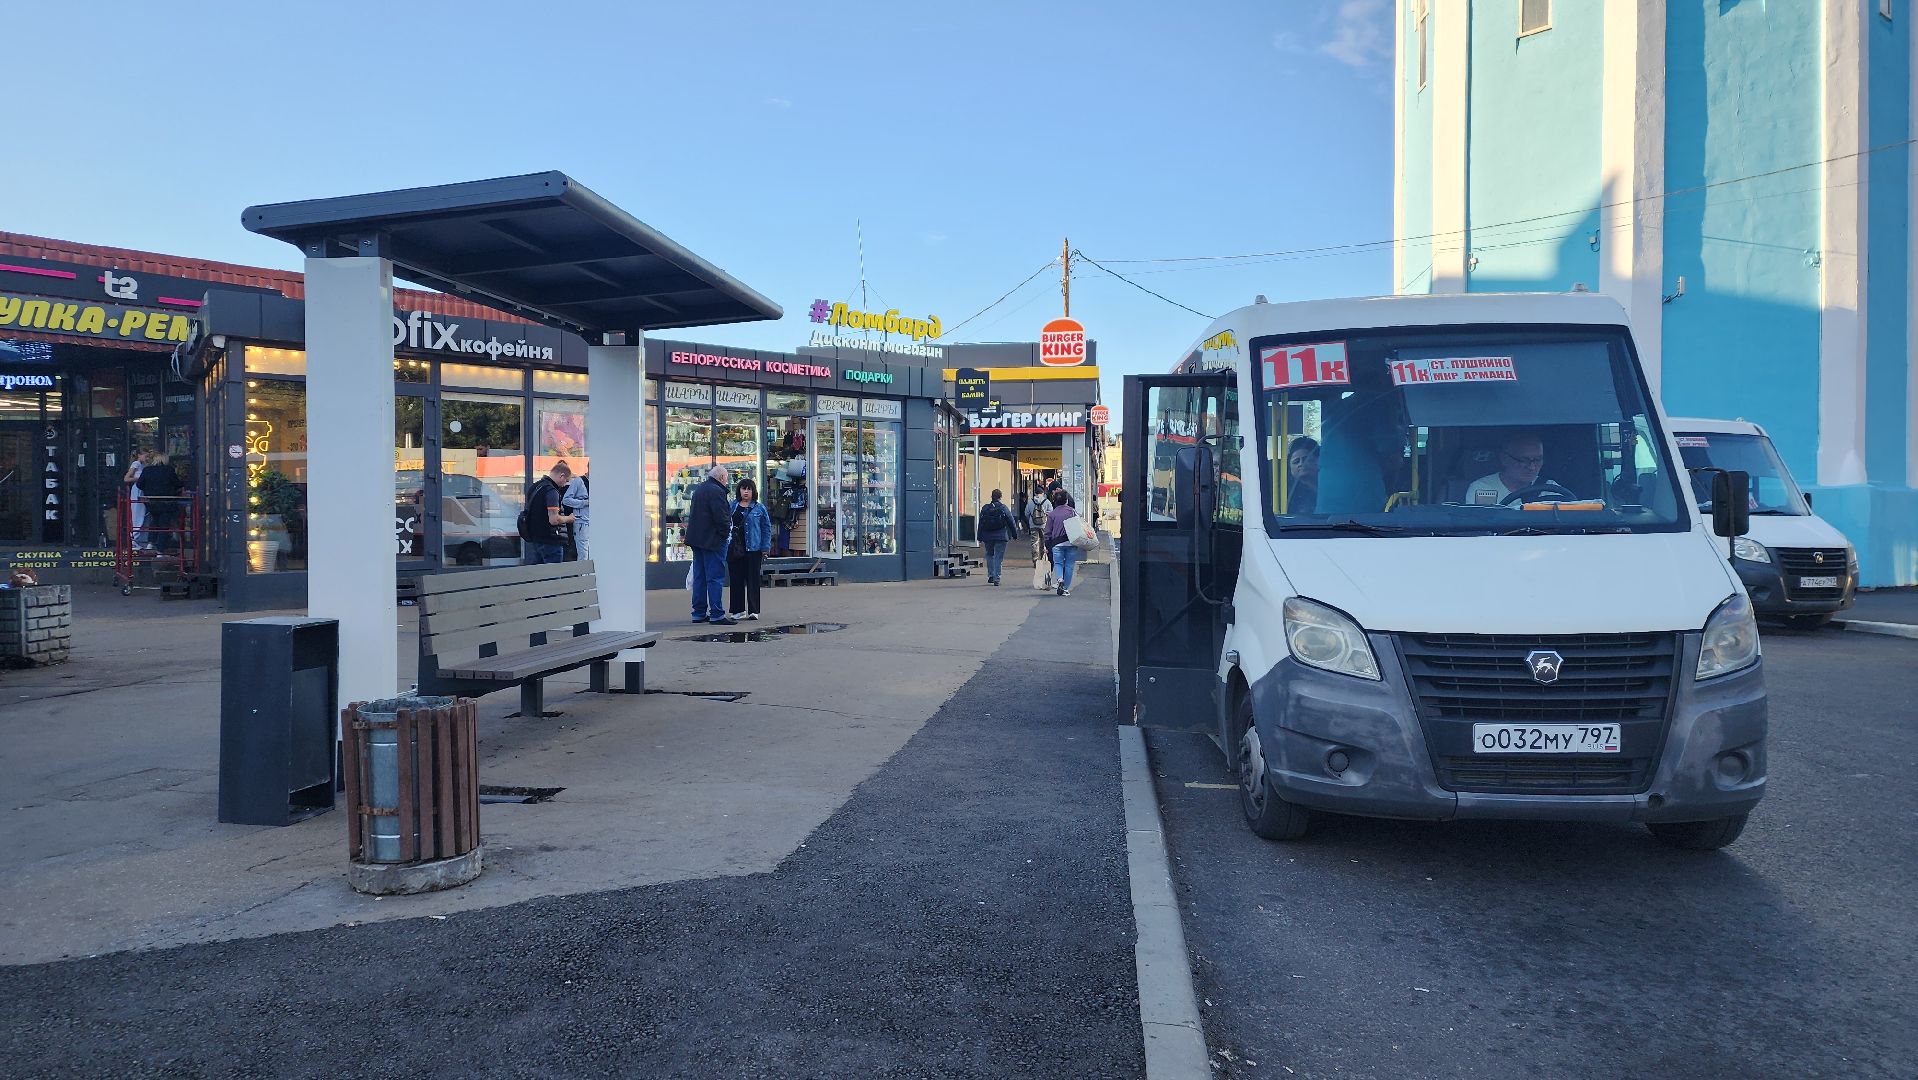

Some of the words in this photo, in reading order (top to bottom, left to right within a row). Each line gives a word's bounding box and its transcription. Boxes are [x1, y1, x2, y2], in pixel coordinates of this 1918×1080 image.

[104, 271, 138, 299] t2
[809, 330, 880, 352] Дисконт
[884, 342, 943, 358] магазин
[1042, 333, 1083, 342] BURGER
[460, 337, 553, 360] кофейня
[1042, 343, 1083, 356] KING
[671, 351, 760, 371] БЕЛОРУССКАЯ
[765, 361, 831, 377] КОСМЕТИКА
[1264, 348, 1345, 385] 11к
[1451, 358, 1510, 369] ПУШКИНО
[845, 369, 893, 384] ПОДАРКИ
[1394, 363, 1429, 382] 11к
[1464, 370, 1515, 379] АРМАНД
[666, 386, 709, 400] ШАРЫ
[717, 390, 758, 406] ШАРЫ
[817, 400, 854, 412] СВЕЧИ
[865, 402, 897, 415] ШАРЫ
[970, 412, 1032, 428] БУРГЕР
[1036, 412, 1082, 427] КИНГ
[45, 446, 59, 520] ТАБАК
